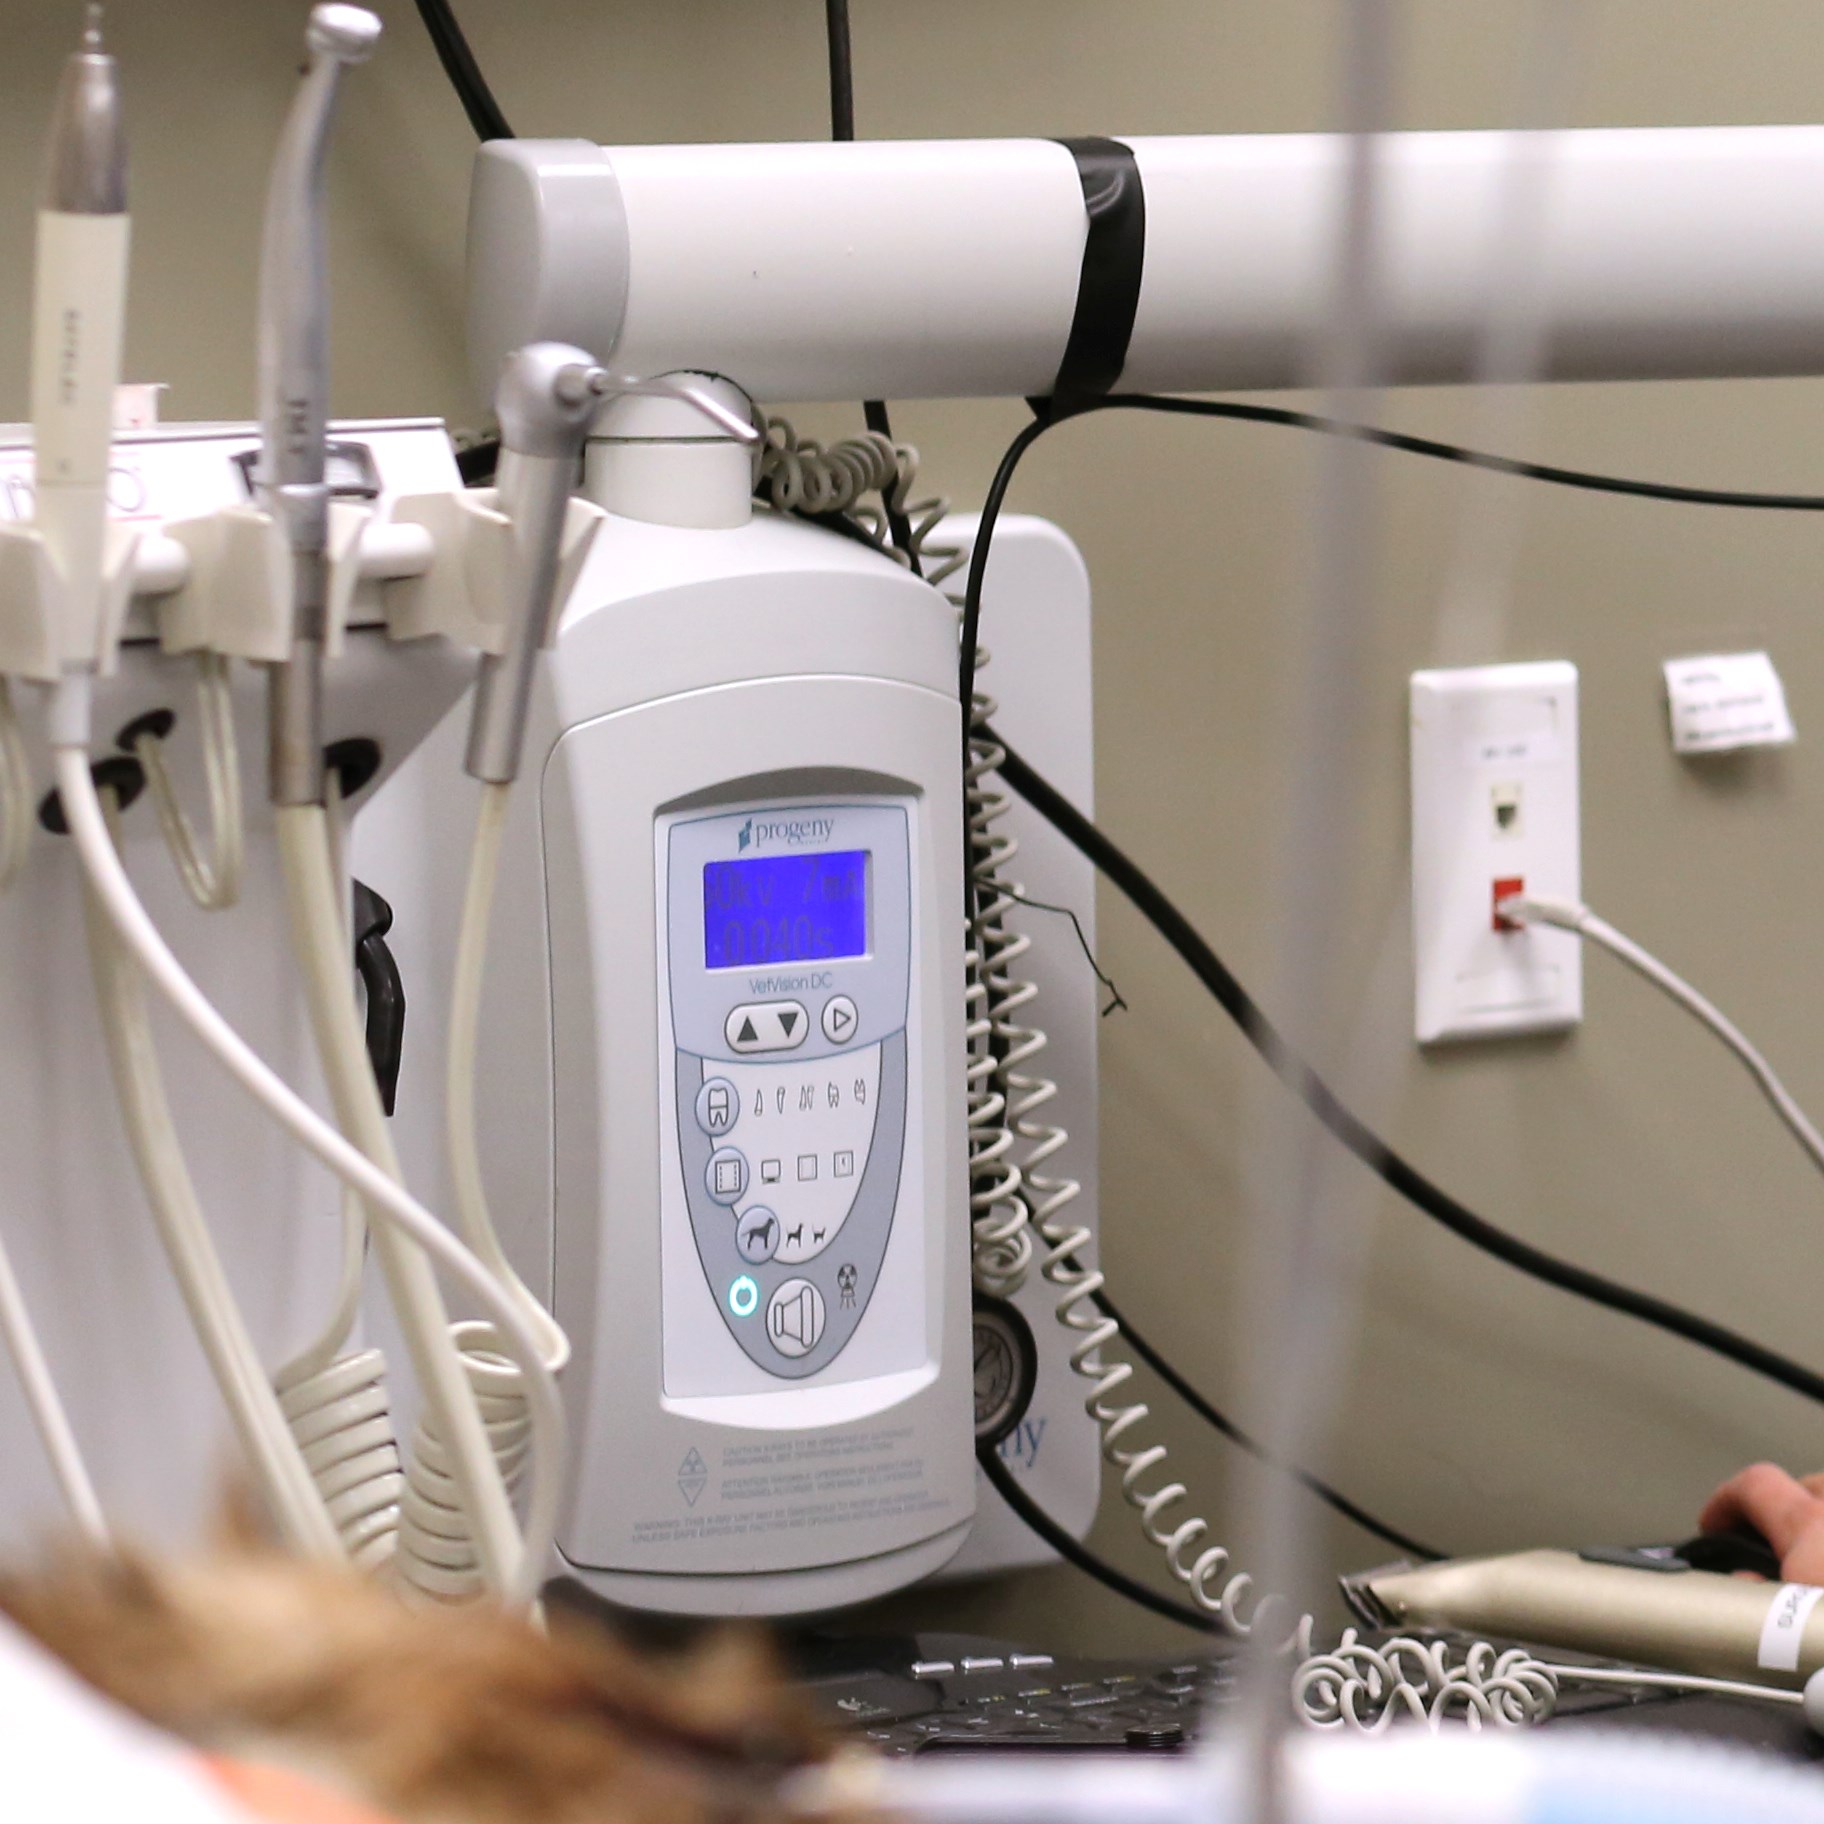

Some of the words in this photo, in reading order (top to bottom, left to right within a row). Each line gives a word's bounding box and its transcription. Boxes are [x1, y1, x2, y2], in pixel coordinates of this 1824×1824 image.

[755, 818, 834, 848] progeny
[749, 976, 809, 995] VetVision
[811, 973, 833, 989] DC
